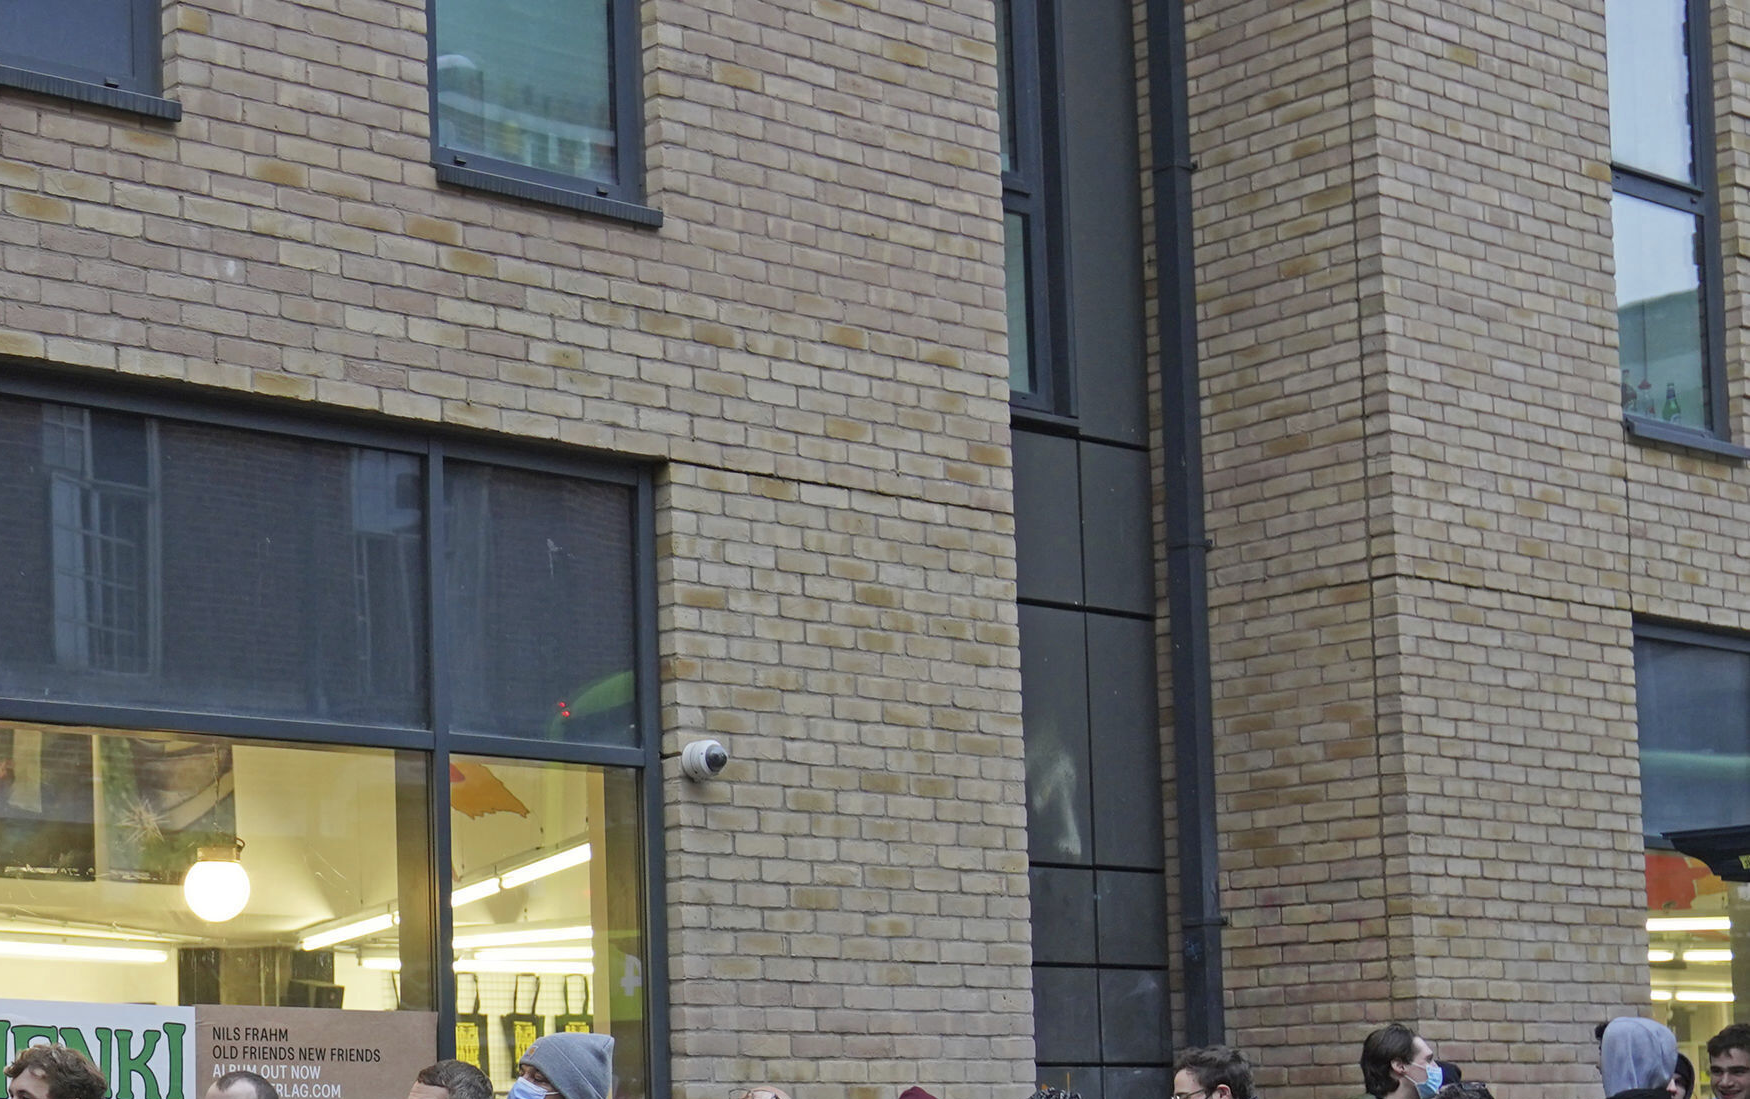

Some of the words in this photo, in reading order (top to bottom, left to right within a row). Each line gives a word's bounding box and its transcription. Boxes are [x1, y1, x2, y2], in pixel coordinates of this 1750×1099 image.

[212, 1026, 241, 1041] NILS
[244, 1027, 289, 1042] FRAHM
[212, 1045, 238, 1060] OLD
[242, 1046, 295, 1061] FRIENDS
[299, 1047, 327, 1062] NEW
[330, 1048, 381, 1063] FRIENDS
[260, 1065, 287, 1079] OUT
[291, 1065, 321, 1080] NOW
